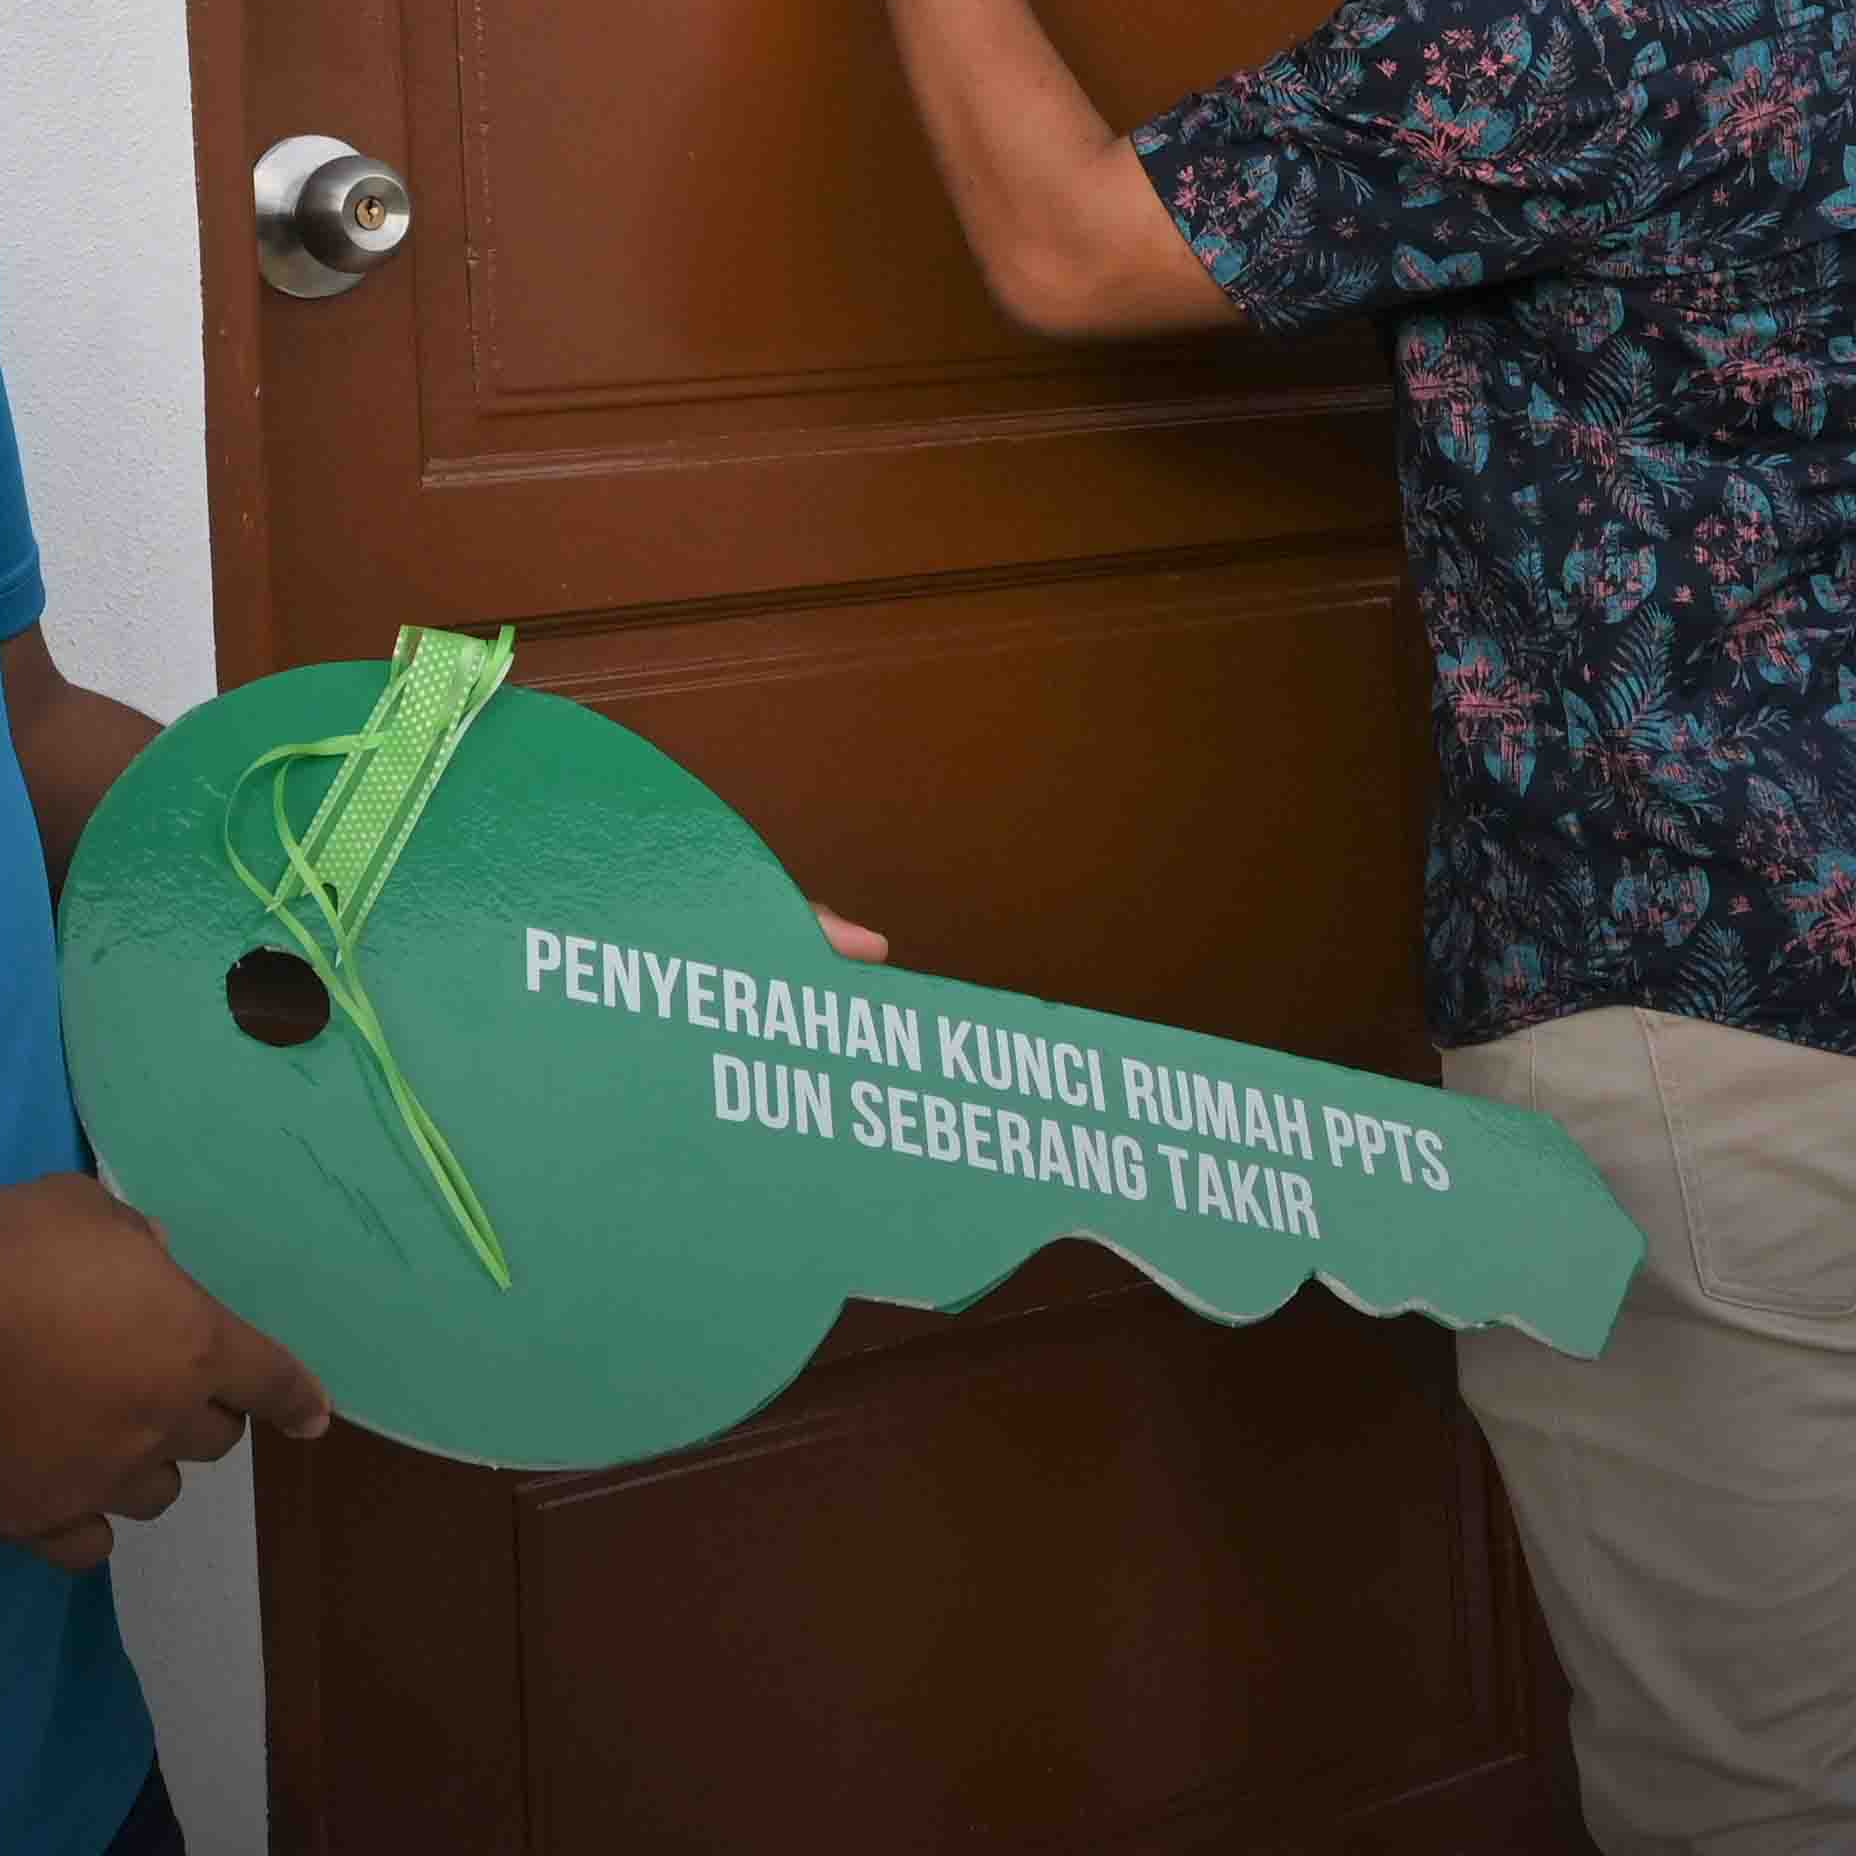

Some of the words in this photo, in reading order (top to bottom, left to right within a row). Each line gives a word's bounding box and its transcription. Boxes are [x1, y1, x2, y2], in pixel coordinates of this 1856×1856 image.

[524, 927, 923, 1075] PENYERAHAN
[936, 1015, 1105, 1113] KUNCI
[1120, 1056, 1311, 1161] RUMAH
[1322, 1104, 1452, 1193] PPTS
[711, 1052, 834, 1140] DUN
[850, 1080, 1148, 1202] SEBERANG
[1157, 1144, 1322, 1240] TAKIR
